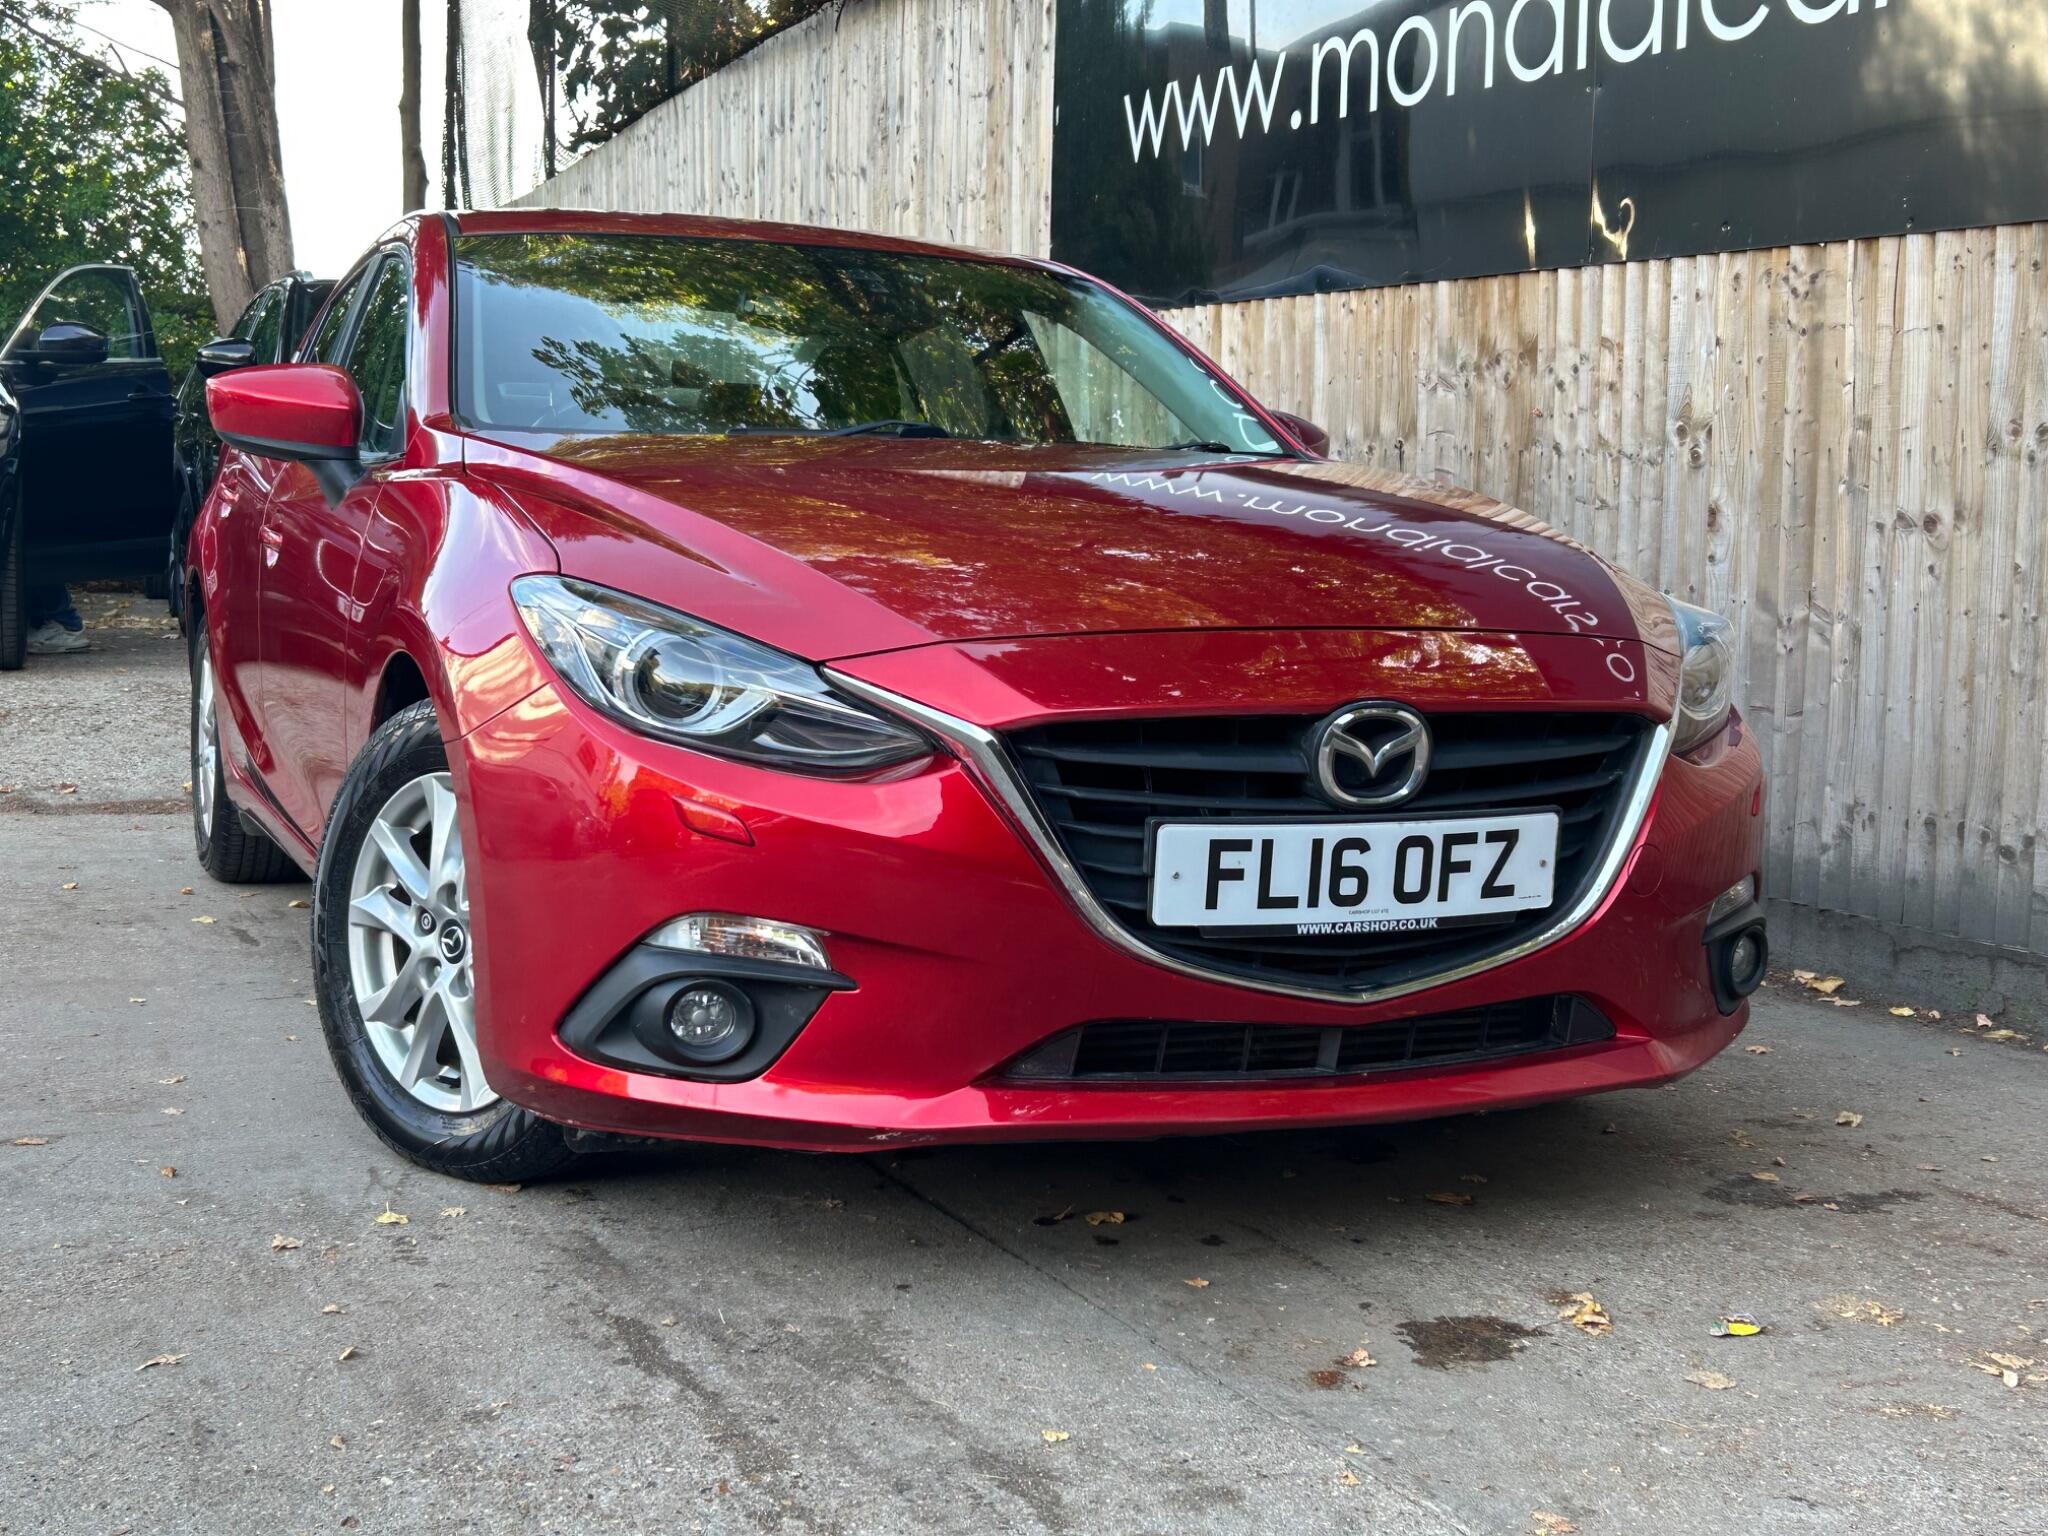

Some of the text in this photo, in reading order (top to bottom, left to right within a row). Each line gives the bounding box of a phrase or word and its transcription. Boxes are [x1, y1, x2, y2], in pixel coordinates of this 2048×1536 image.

[1205, 829, 1520, 910] FL16 OFZ
[1297, 918, 1438, 935] WWW.CARSHOP.CO.UK
